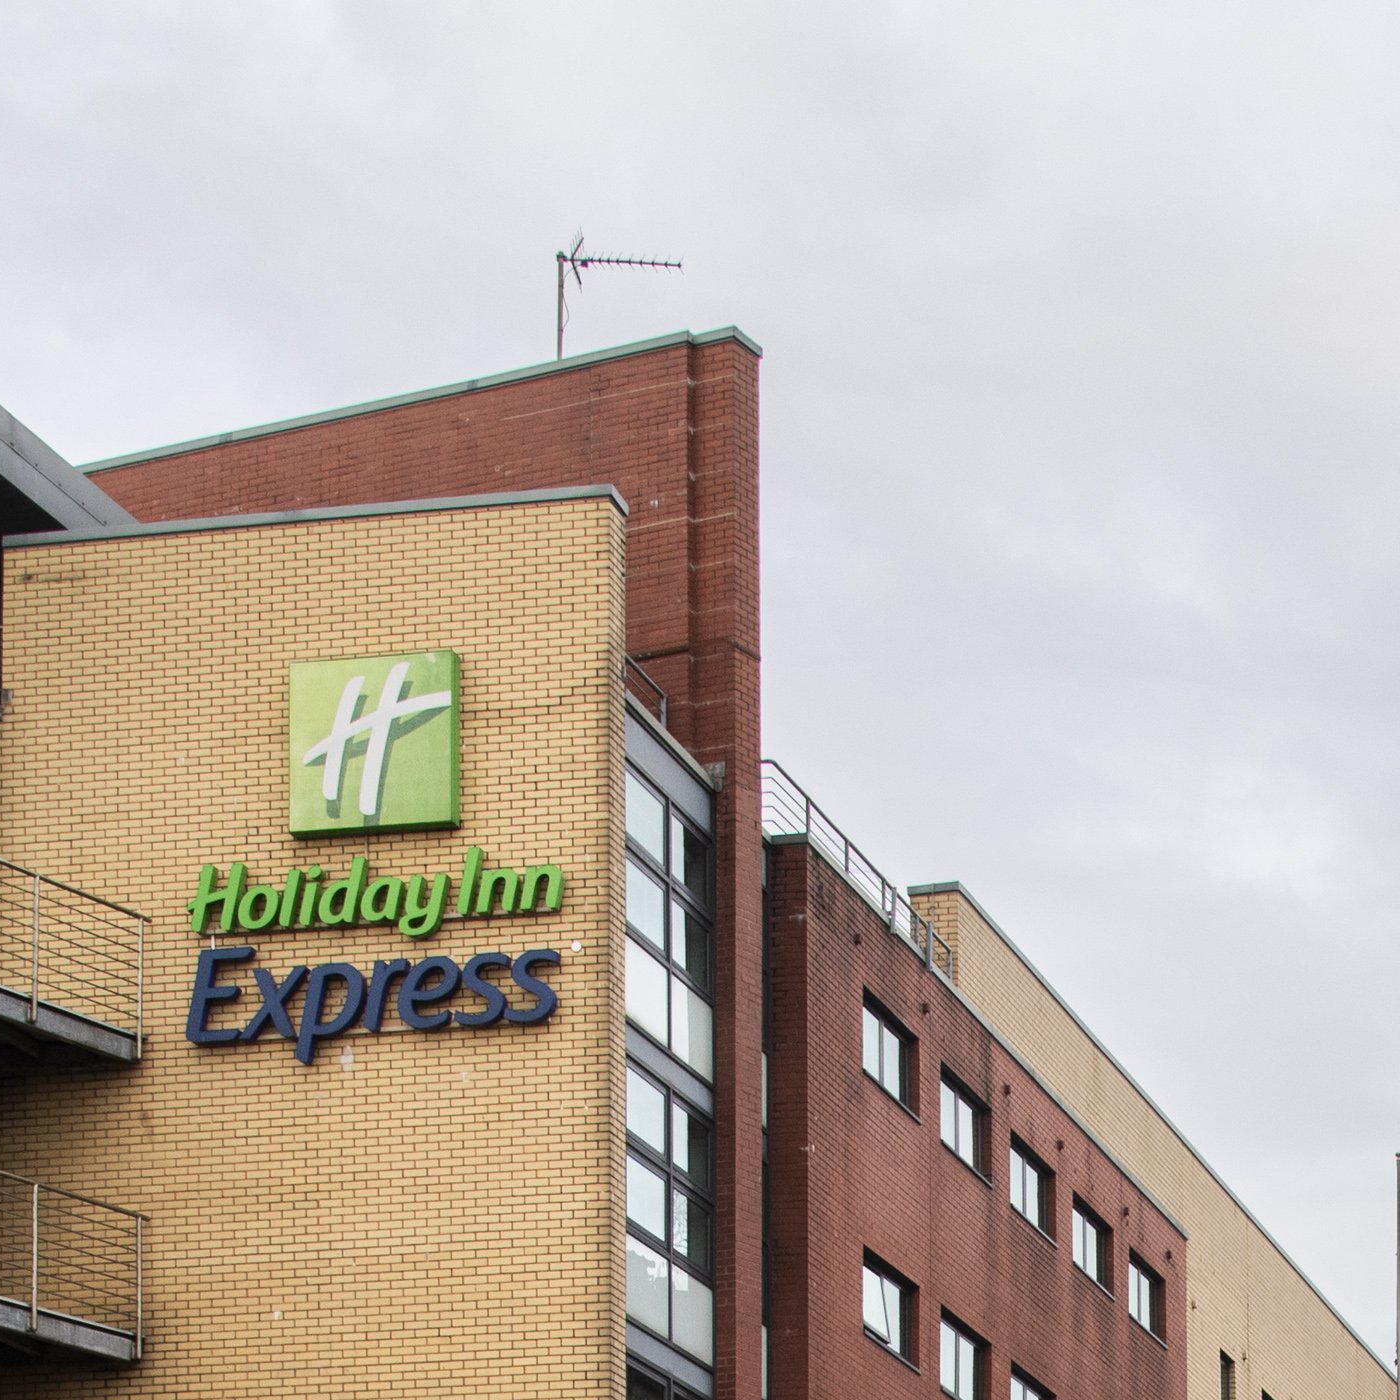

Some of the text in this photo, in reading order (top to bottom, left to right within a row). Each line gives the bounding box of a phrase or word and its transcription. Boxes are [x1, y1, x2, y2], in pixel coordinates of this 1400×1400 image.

[187, 846, 565, 938] Holiday Inn
[186, 946, 561, 1066] Express
